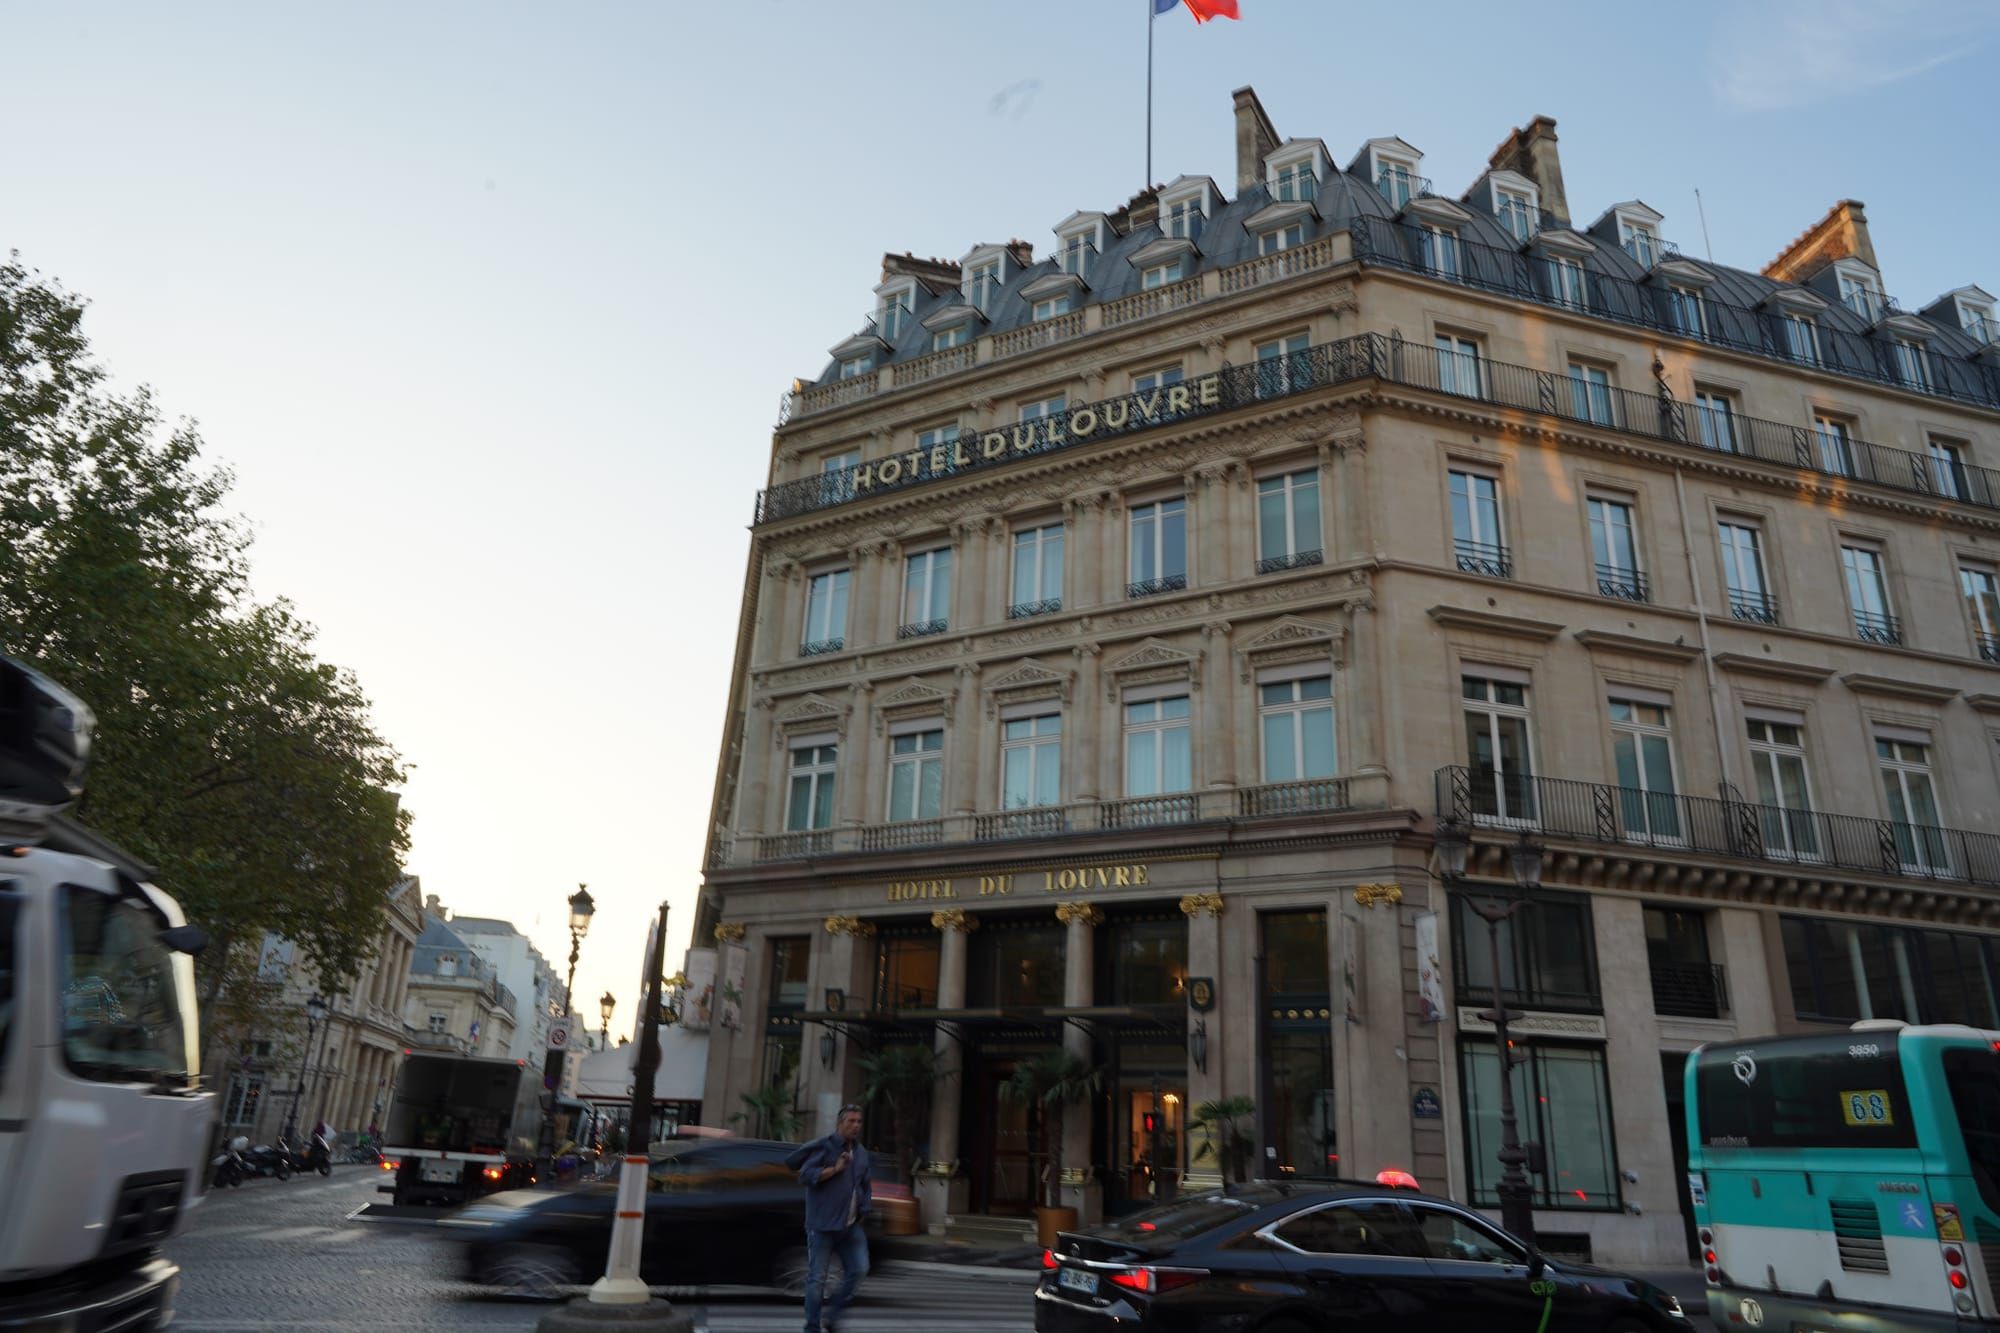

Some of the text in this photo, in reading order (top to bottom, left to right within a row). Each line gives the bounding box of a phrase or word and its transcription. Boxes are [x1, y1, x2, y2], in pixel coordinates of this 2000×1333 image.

[852, 376, 1220, 492] HOTEL DU LOUVRE
[979, 875, 1015, 895] DU
[1044, 865, 1149, 892] LOUVRE
[1850, 1093, 1886, 1121] 68
